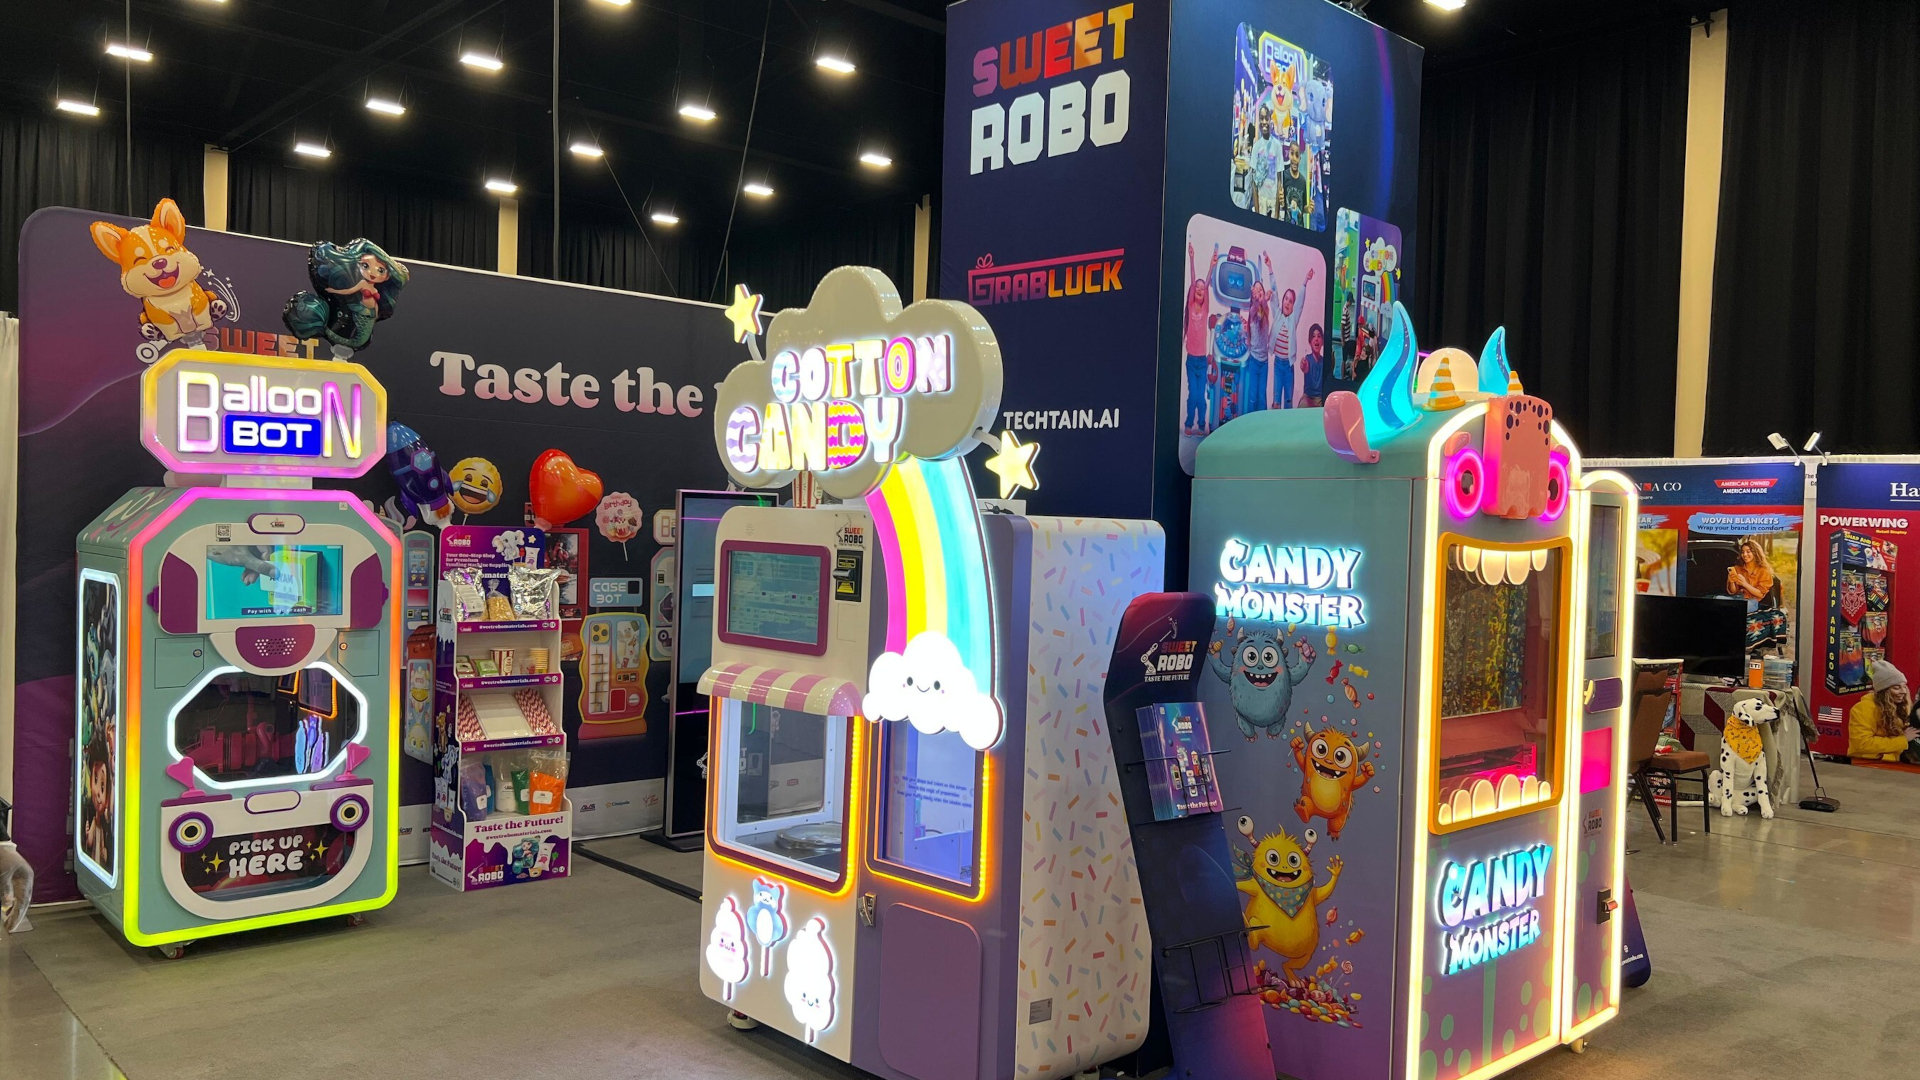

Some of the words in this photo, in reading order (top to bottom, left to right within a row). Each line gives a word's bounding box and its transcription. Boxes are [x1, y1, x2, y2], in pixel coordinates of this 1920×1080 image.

[972, 2, 1135, 98] SWEET
[969, 69, 1131, 176] ROBO
[968, 258, 1125, 306] GRABLUCK
[204, 327, 320, 359] SWEET
[771, 334, 952, 403] COTTON
[430, 351, 600, 409] Taste
[611, 367, 704, 418] the
[1003, 408, 1120, 430] TECHTAIN.AI
[232, 420, 313, 449] BOT
[726, 396, 904, 473] CANDY
[1663, 482, 1682, 492] CO
[1701, 517, 1733, 525] WOVEN
[1734, 517, 1779, 525] BLANKETS
[844, 534, 863, 544] ROBO
[1220, 538, 1362, 590] CANDY
[592, 582, 627, 593] CASE
[1214, 581, 1367, 629] MONSTER
[1161, 641, 1197, 653] SWEET
[1157, 654, 1194, 672] ROBO
[474, 823, 503, 833] Taste
[505, 821, 523, 830] the
[523, 815, 564, 828] Future!
[1588, 817, 1603, 831] ROBO
[229, 837, 275, 856] PICK
[279, 835, 304, 849] UP
[229, 850, 304, 879] HERE
[478, 871, 504, 882] ROBO
[1435, 842, 1553, 927] CANDY
[1441, 907, 1542, 976] MONSTER
